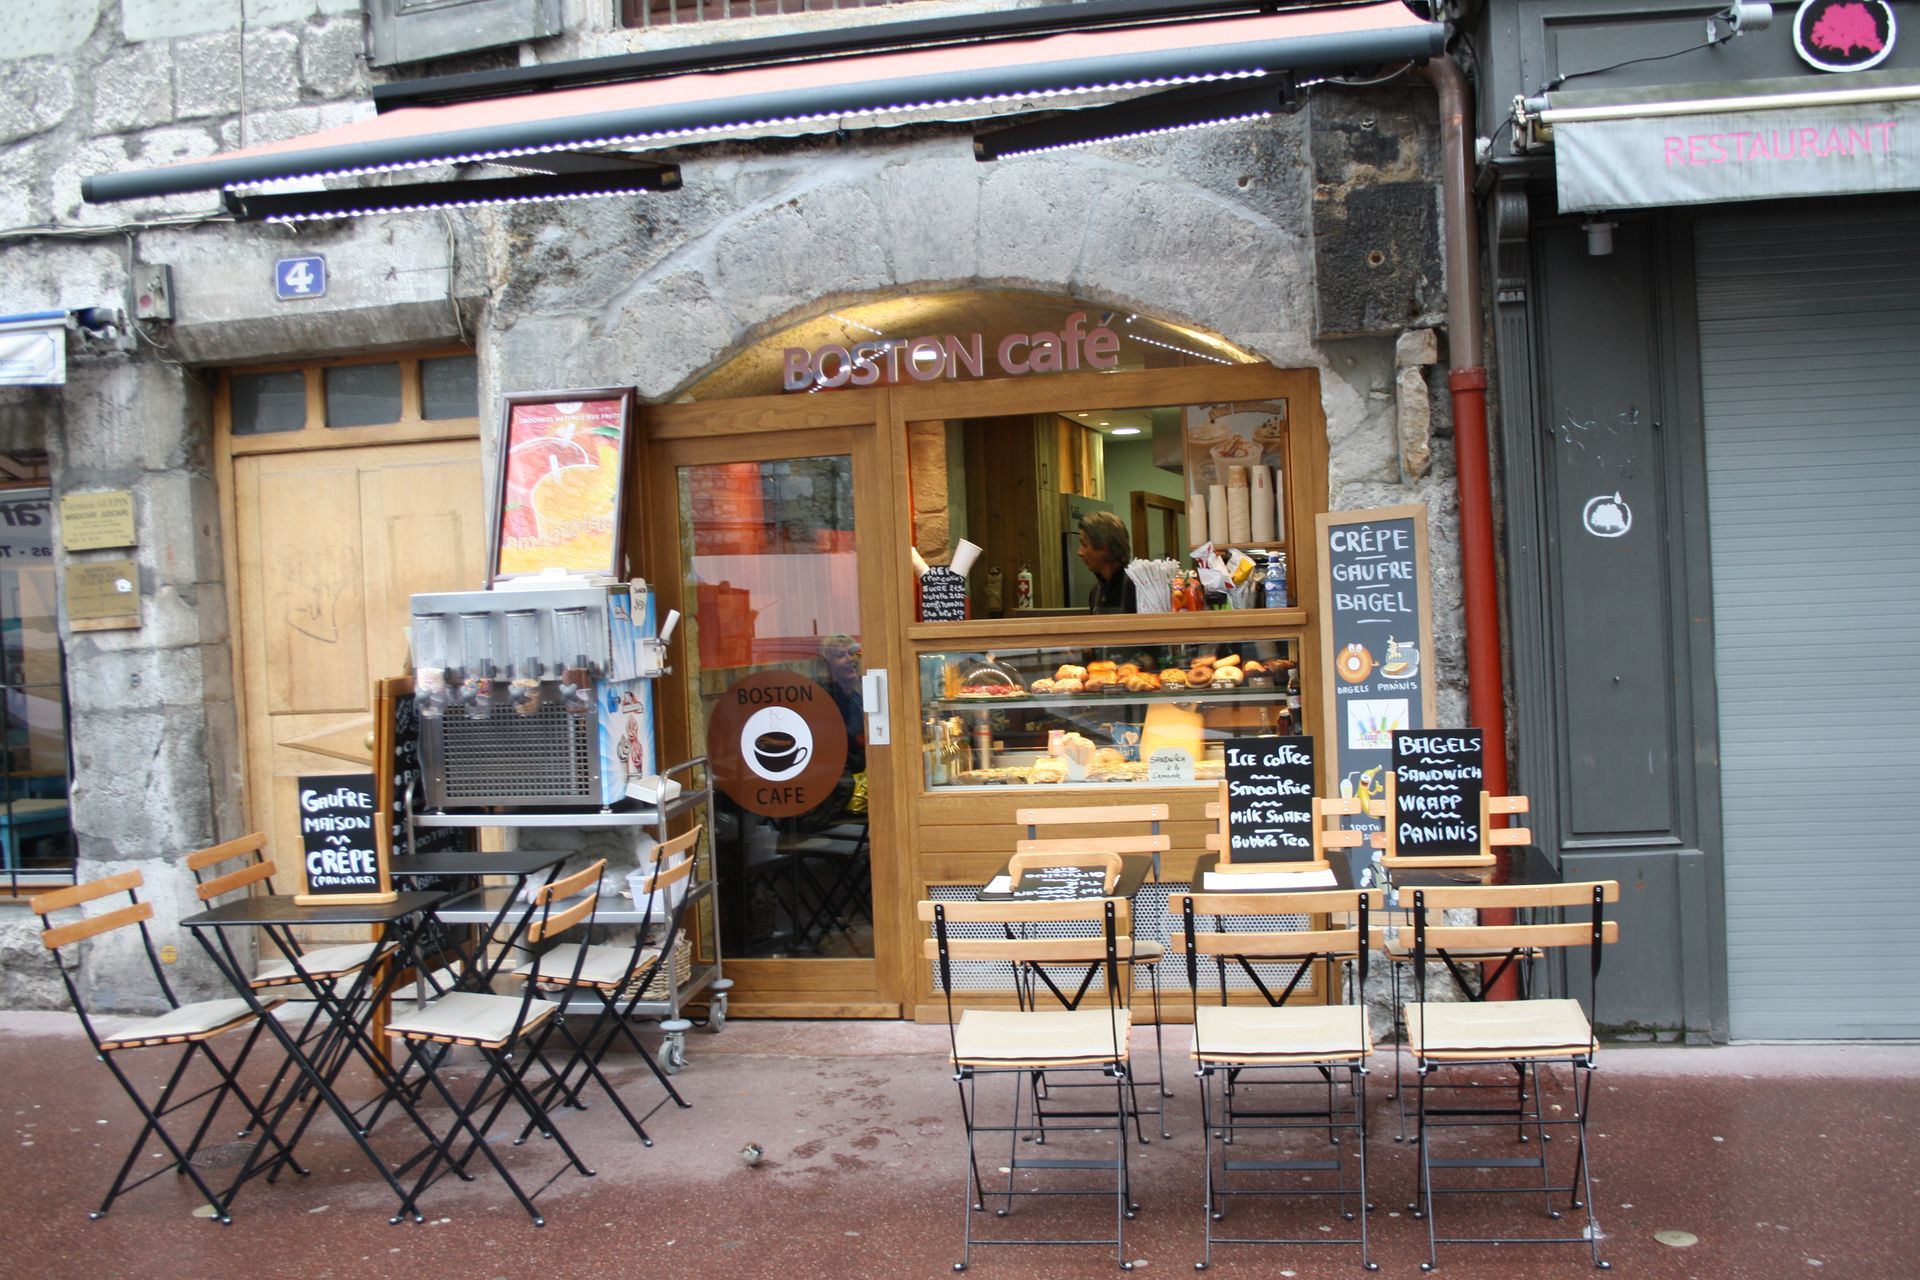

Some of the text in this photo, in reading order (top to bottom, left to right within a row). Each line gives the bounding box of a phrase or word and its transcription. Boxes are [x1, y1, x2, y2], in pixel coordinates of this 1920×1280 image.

[1663, 121, 1898, 166] RESTAURANT
[285, 261, 314, 293] 4
[783, 311, 1121, 391] BOSTON café
[1330, 525, 1409, 552] CRÊPE
[1333, 561, 1412, 581] GAUFRE
[1335, 591, 1412, 612] BAGEL
[737, 685, 813, 705] BOSTON
[1337, 685, 1369, 695] BAGELS
[1398, 736, 1481, 755] BAGELS
[756, 787, 805, 805] CAFE
[1229, 779, 1312, 796] Smoothie
[1398, 794, 1462, 812] WRAPP
[1231, 833, 1310, 848] Bubble Tea
[307, 846, 376, 875] CRÊPE
